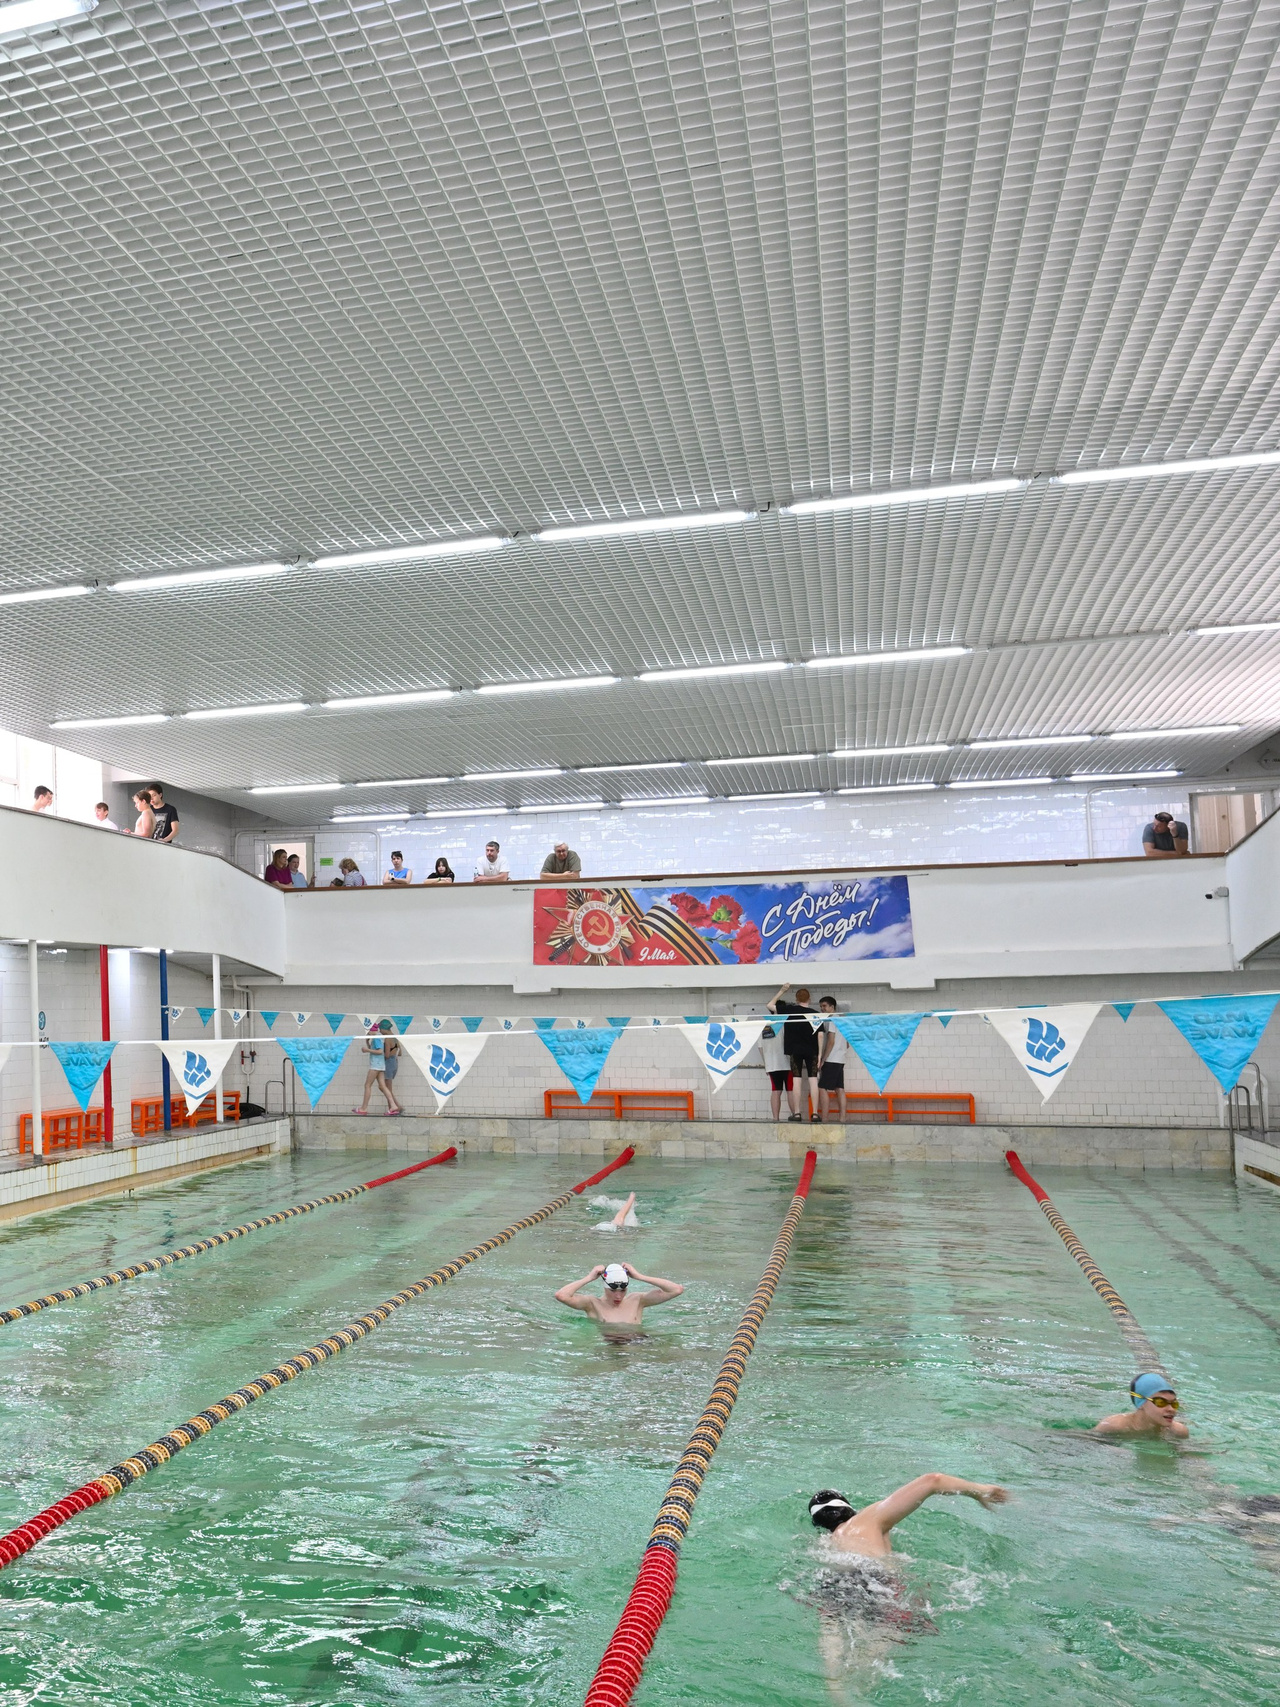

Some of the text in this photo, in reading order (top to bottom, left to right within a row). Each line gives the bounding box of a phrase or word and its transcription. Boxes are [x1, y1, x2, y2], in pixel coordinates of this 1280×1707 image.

[761, 882, 862, 938] С Днём
[769, 897, 880, 962] Победы!
